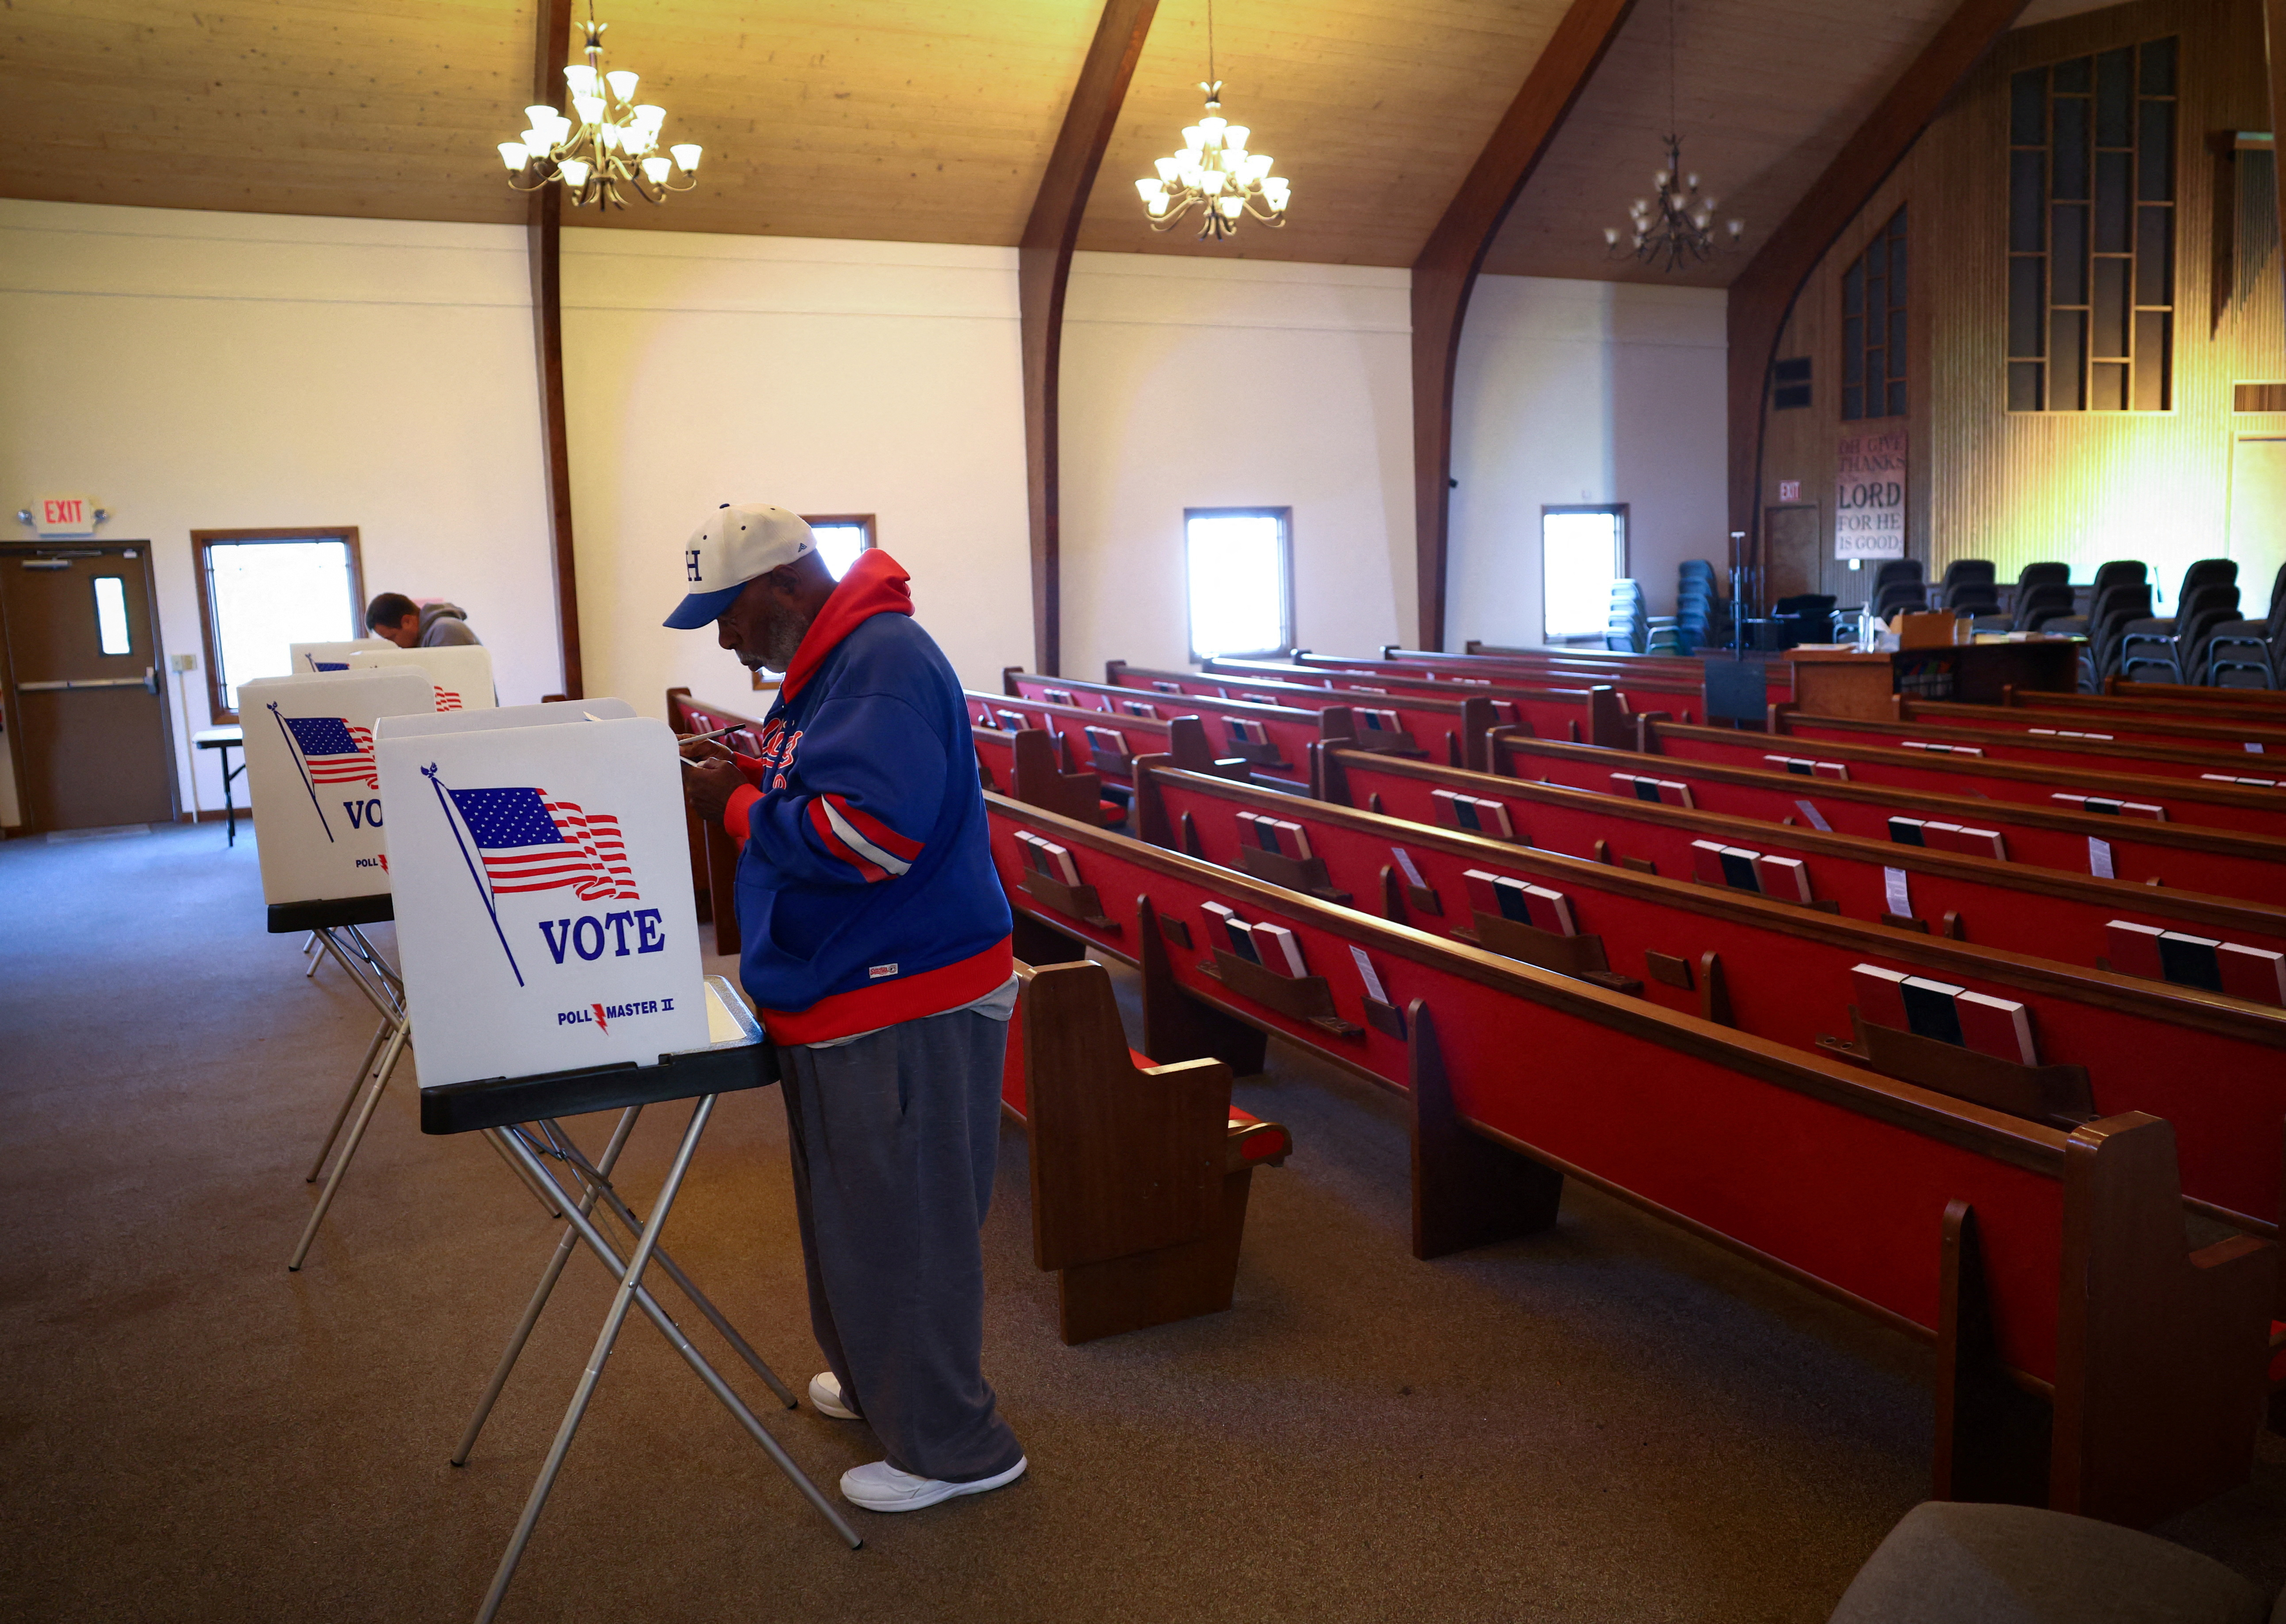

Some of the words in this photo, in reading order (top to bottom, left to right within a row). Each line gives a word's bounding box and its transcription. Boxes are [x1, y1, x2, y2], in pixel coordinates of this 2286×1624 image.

[1840, 482, 1901, 509] LORD
[43, 499, 82, 524] EXIT
[1838, 514, 1872, 531] FOR
[1877, 512, 1901, 530] HE
[1840, 535, 1852, 549] IS
[685, 550, 702, 581] H
[356, 858, 378, 868] POLL
[539, 908, 665, 964] VOTE
[558, 1010, 592, 1025] POLL
[606, 1001, 658, 1019] MASTER
[661, 998, 674, 1011] II
